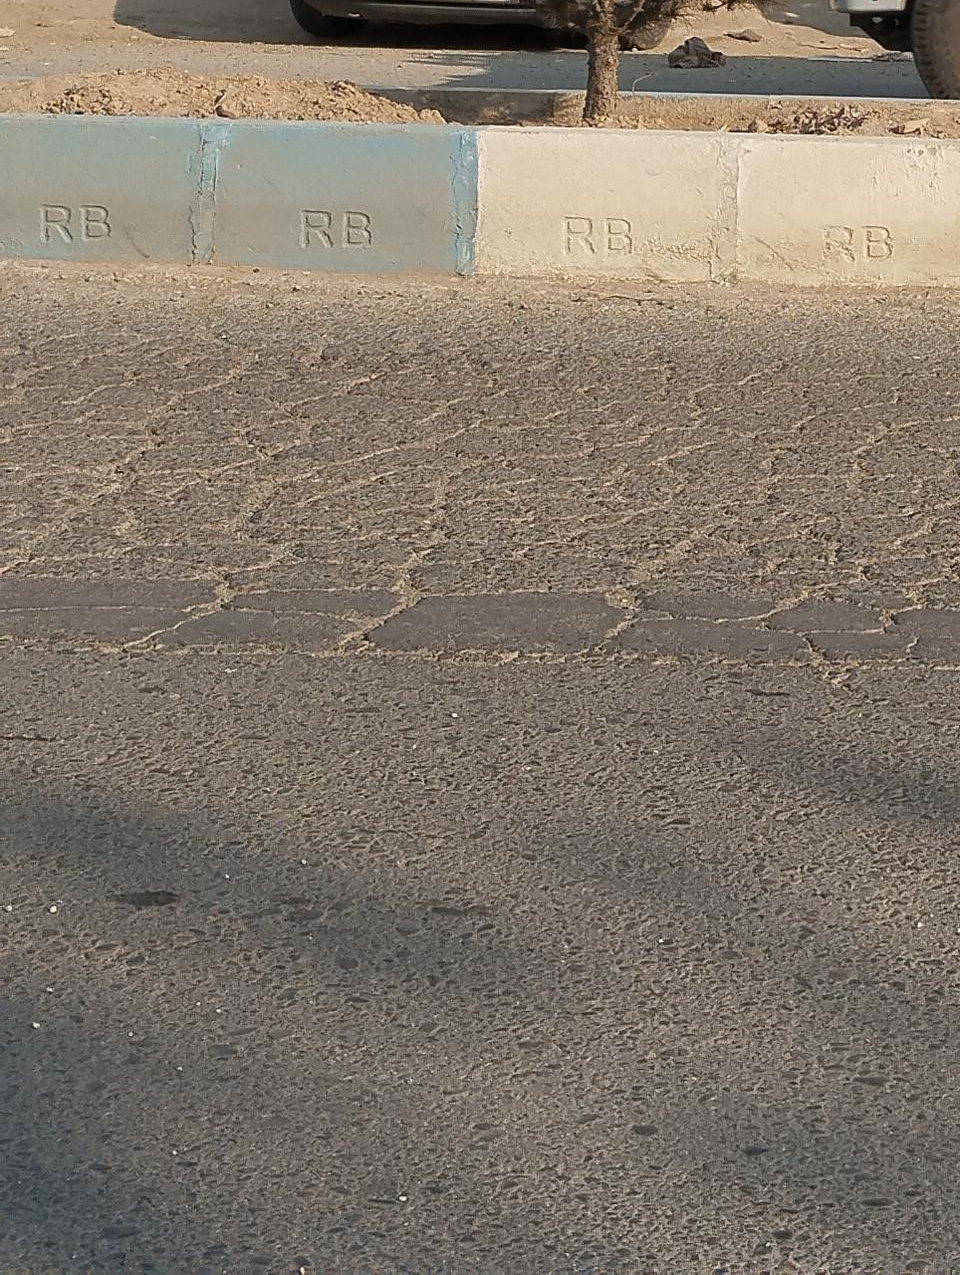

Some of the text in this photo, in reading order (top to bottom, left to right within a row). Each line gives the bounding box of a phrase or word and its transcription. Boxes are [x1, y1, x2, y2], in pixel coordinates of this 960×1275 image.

[38, 202, 112, 243] RB
[299, 209, 374, 249] RB
[563, 215, 634, 256] RB
[823, 224, 894, 263] RB
